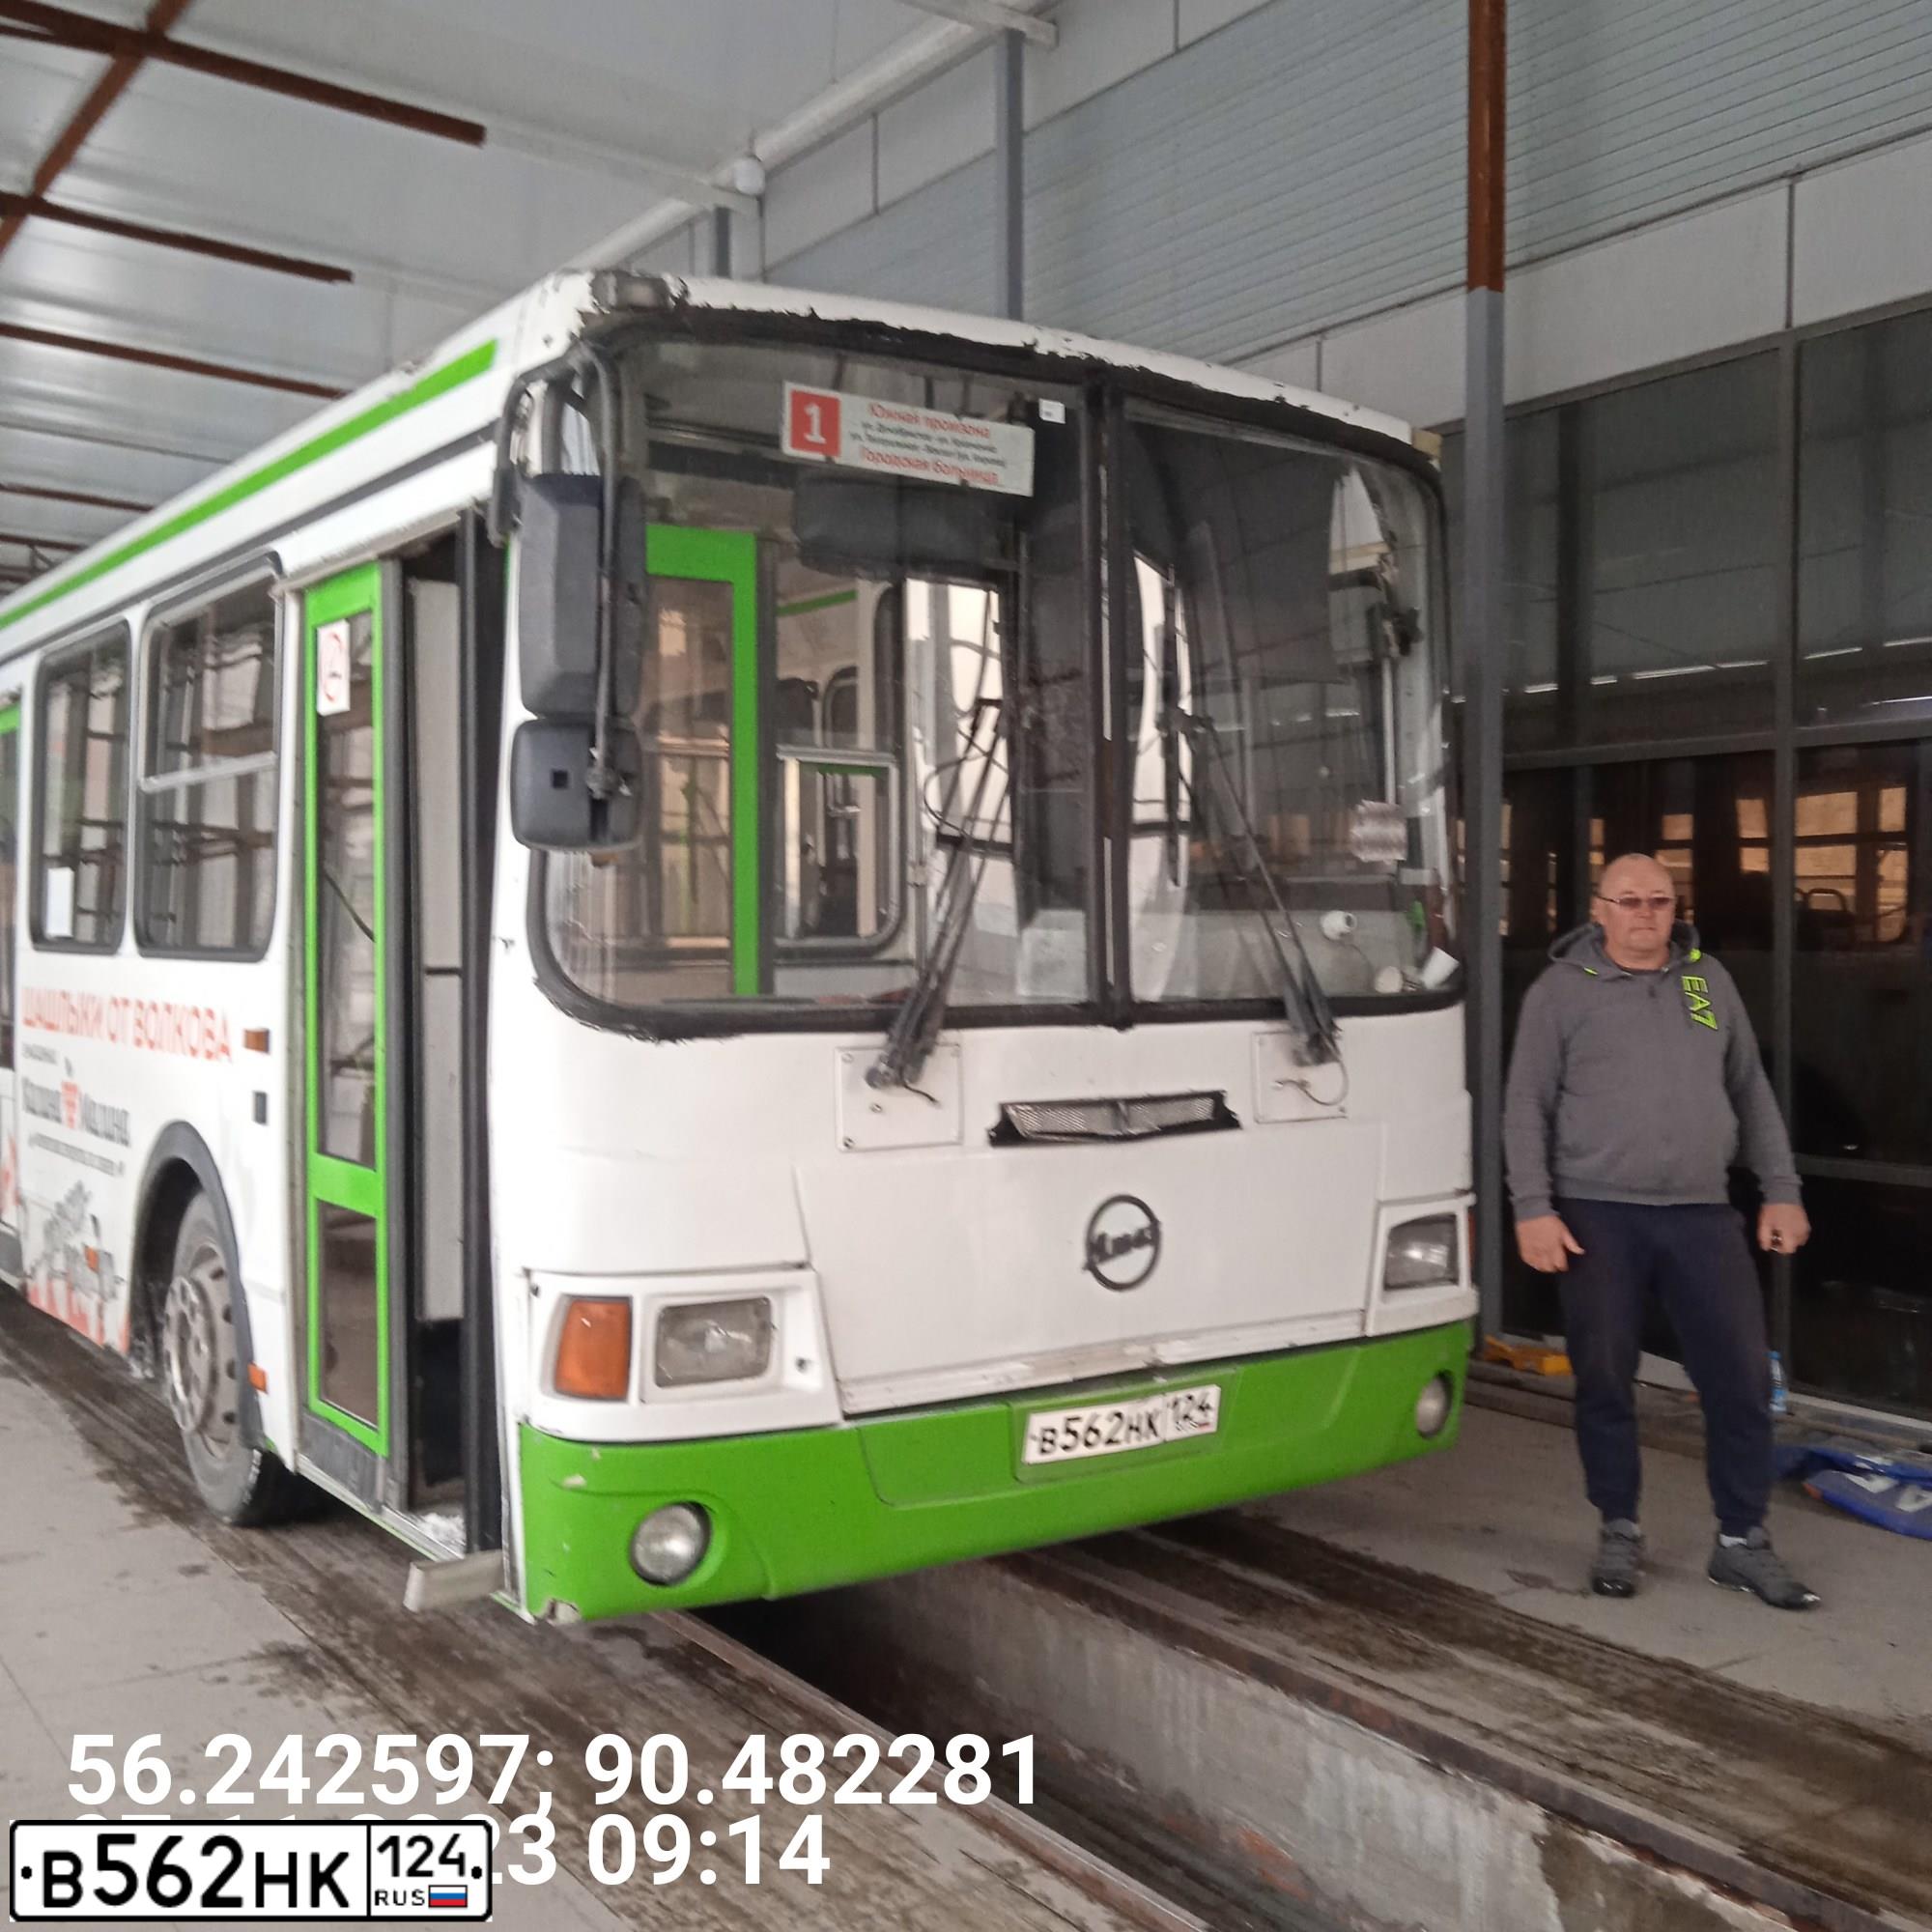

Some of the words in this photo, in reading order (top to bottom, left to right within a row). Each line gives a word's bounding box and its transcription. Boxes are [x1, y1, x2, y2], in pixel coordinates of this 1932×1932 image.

[804, 403, 827, 444] 1
[107, 996, 133, 1045] ОТ
[1681, 974, 1719, 1031] EA7
